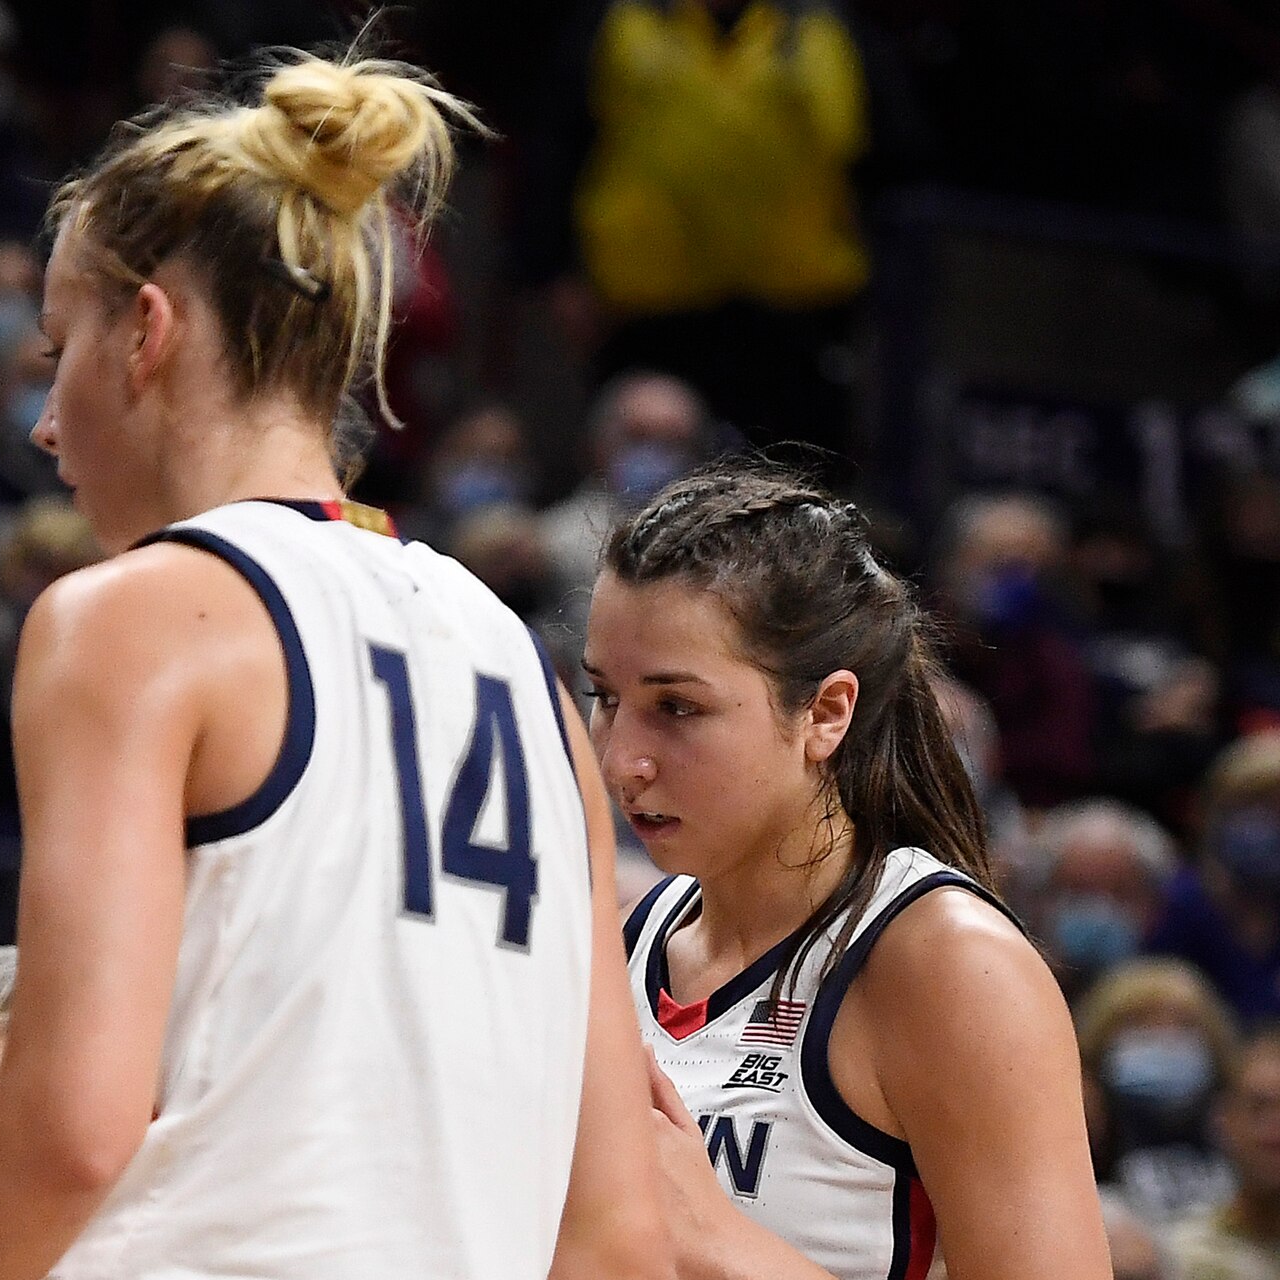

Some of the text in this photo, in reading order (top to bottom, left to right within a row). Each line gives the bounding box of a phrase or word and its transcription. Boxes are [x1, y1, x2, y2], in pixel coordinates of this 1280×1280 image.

[367, 641, 539, 954] 14
[740, 1054, 782, 1070] BIG
[729, 1069, 788, 1086] EAST
